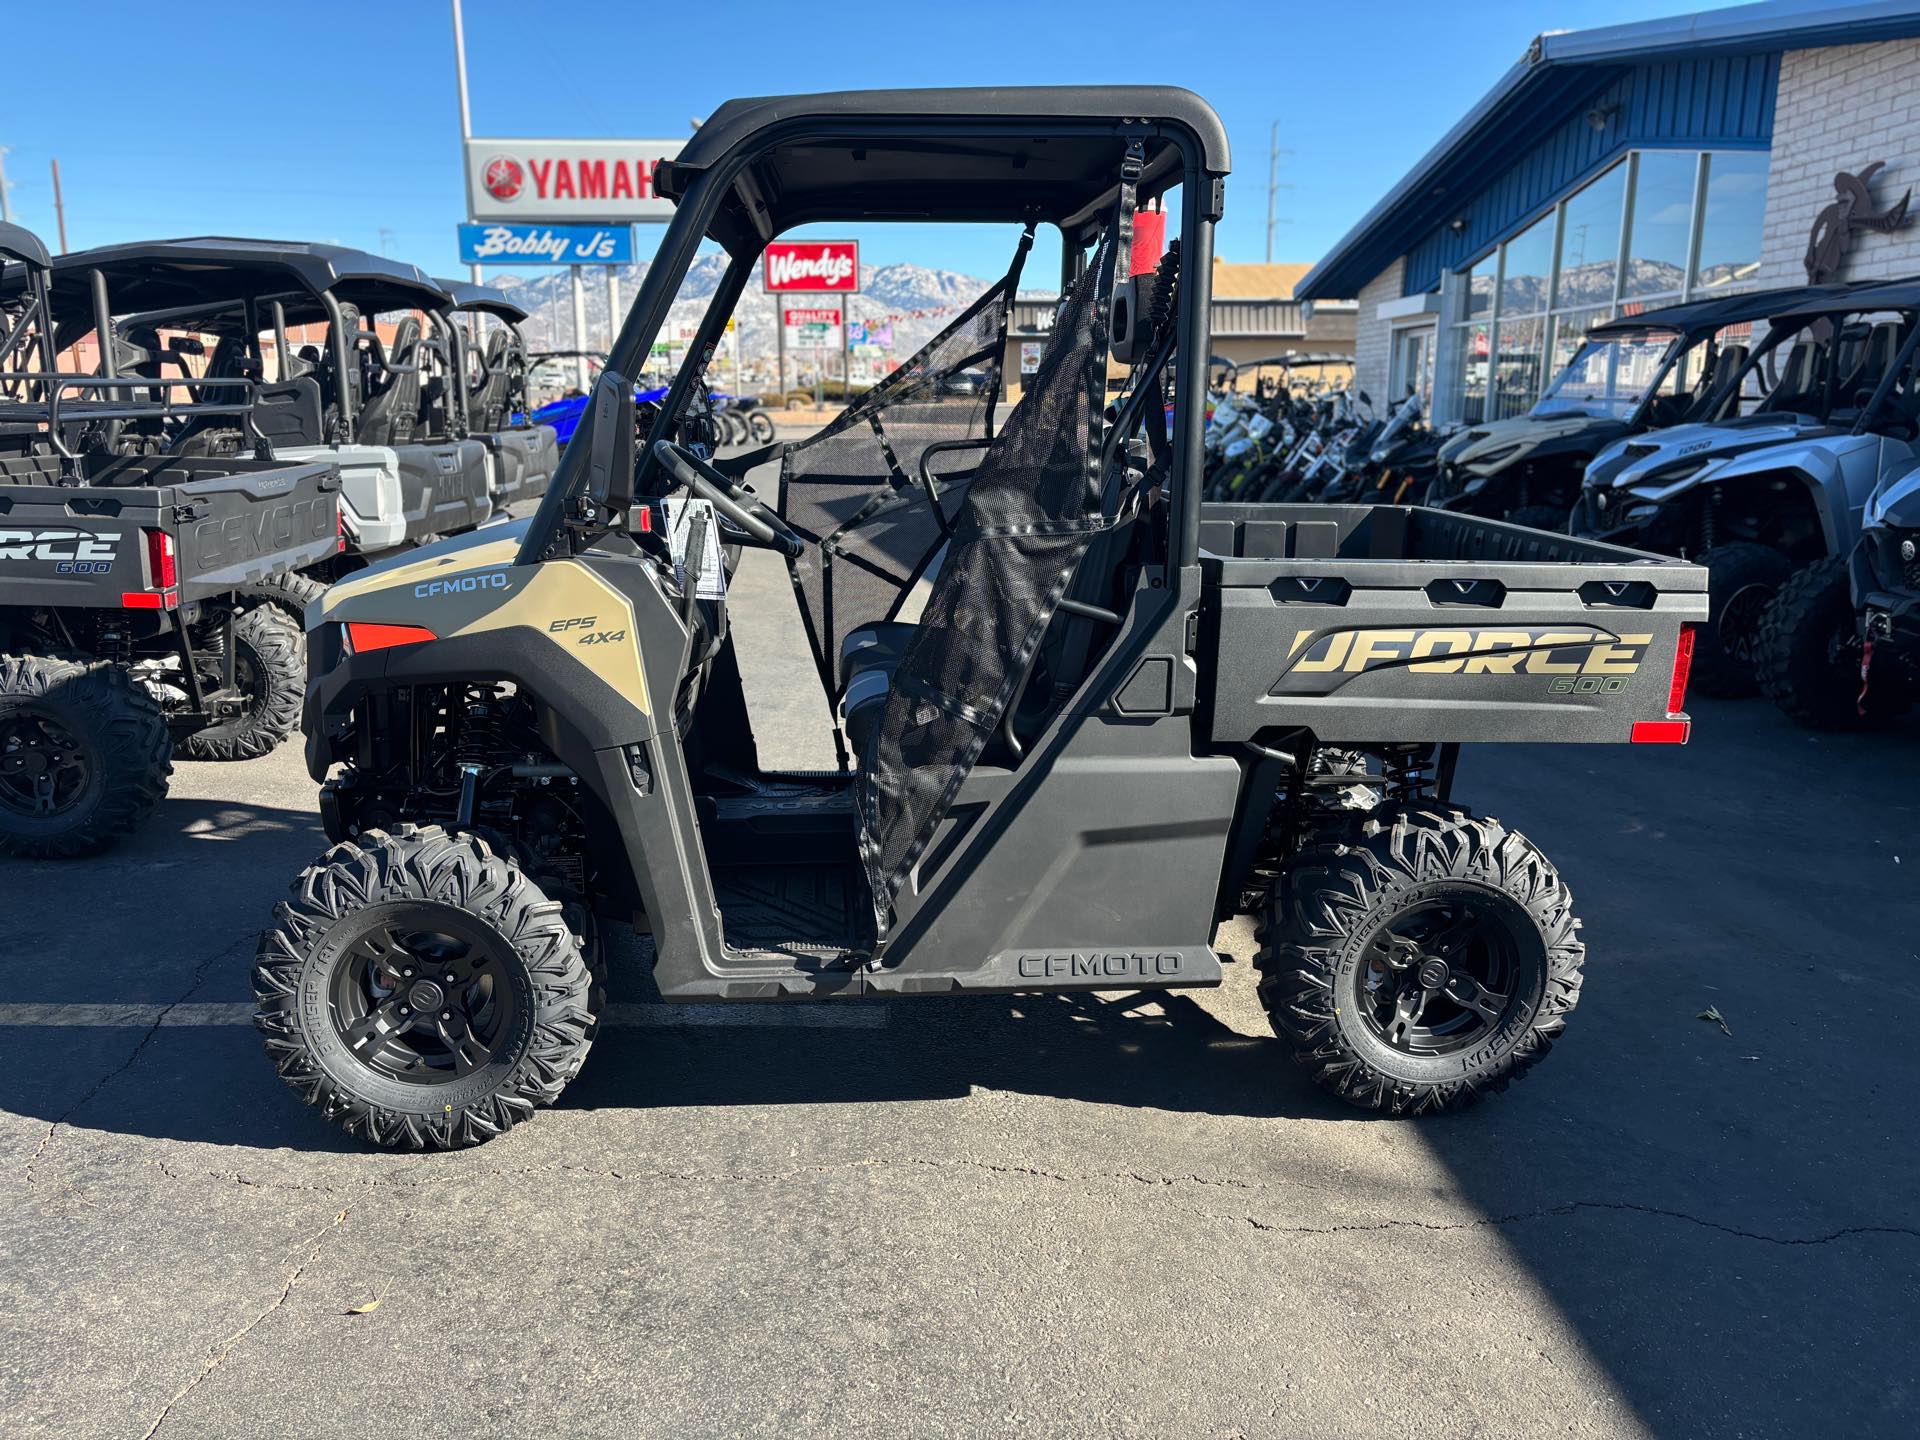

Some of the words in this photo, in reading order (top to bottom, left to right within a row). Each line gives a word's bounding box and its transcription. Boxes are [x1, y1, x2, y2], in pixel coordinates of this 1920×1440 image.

[529, 159, 661, 199] YAMAH
[474, 227, 570, 261] Bobby
[576, 231, 616, 257] J's
[769, 247, 853, 286] Wendy's
[789, 311, 835, 321] QUALITY
[56, 561, 112, 574] 600
[414, 573, 507, 598] CFMOTO
[549, 616, 598, 632] EPS
[578, 630, 626, 646] 4X4
[1287, 630, 1653, 674] UFORCE
[1546, 676, 1631, 694] 600
[1342, 906, 1391, 975] BRUISER
[1018, 951, 1184, 978] CFMOTO
[304, 980, 333, 1057] BRUISER
